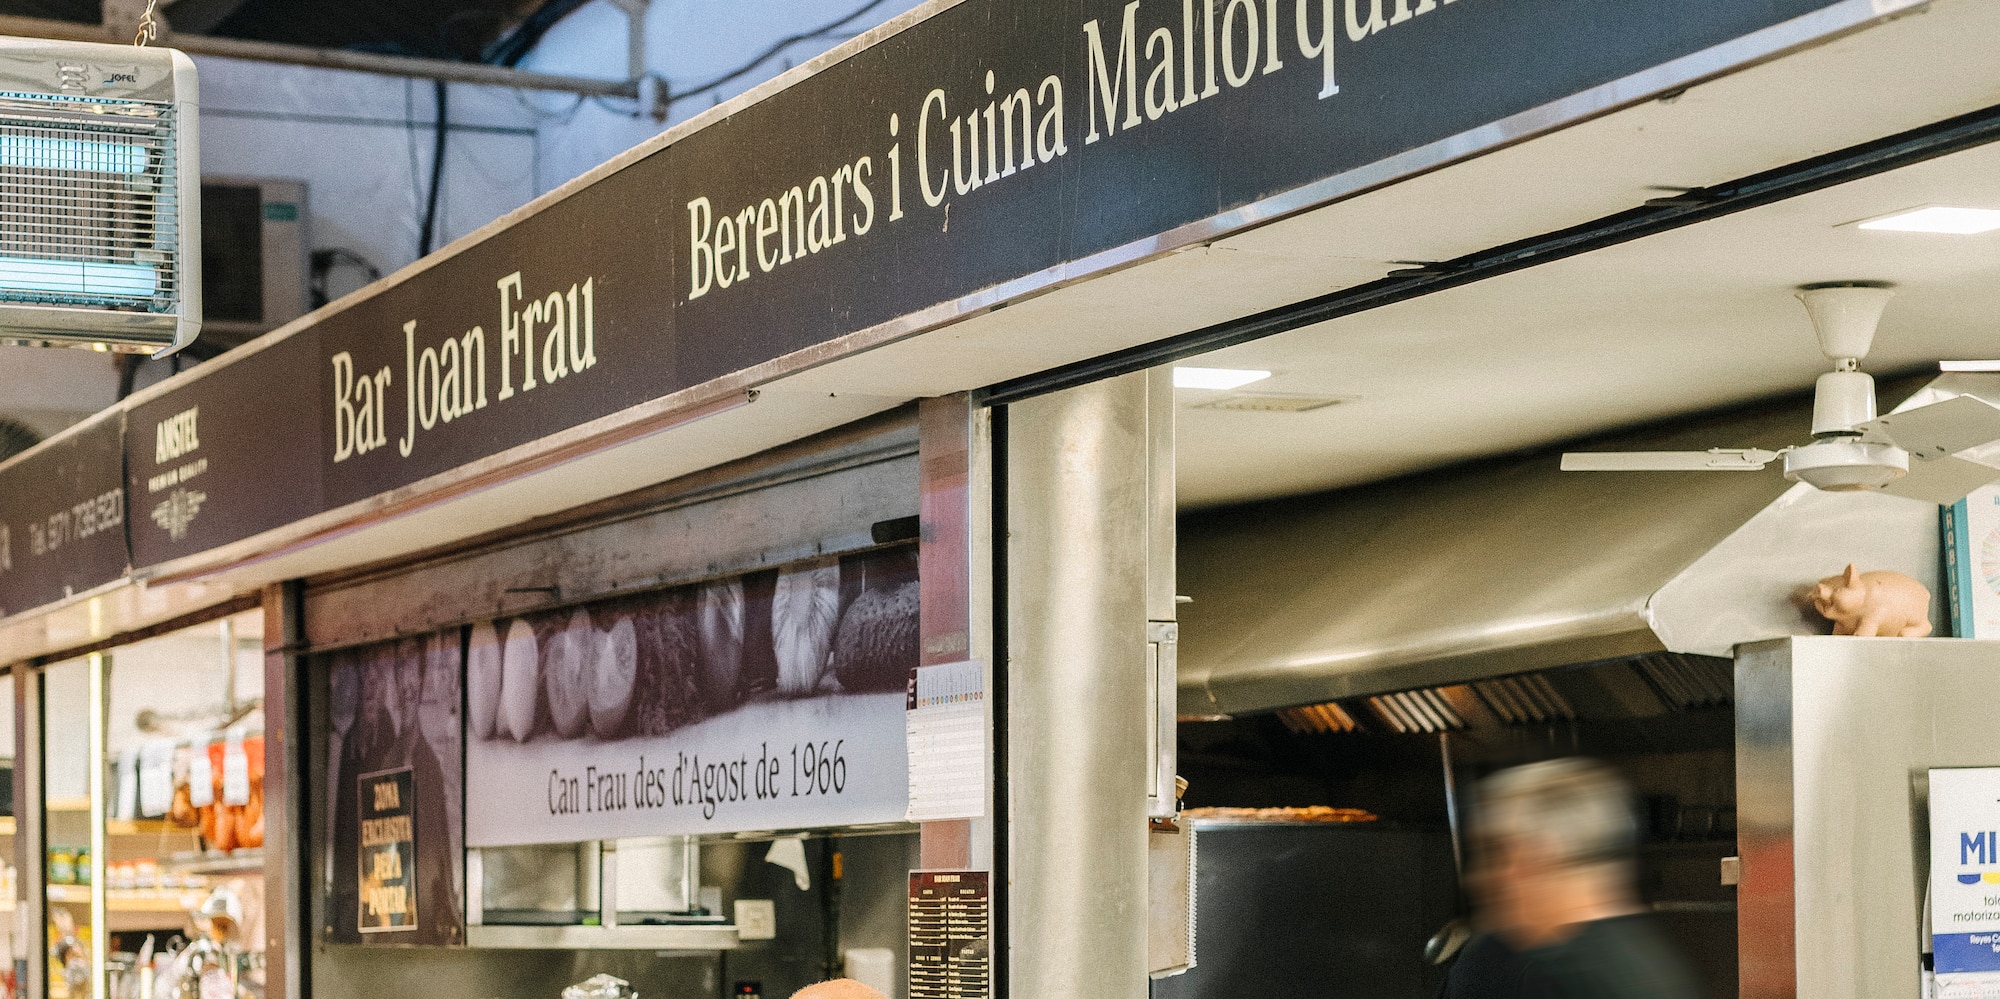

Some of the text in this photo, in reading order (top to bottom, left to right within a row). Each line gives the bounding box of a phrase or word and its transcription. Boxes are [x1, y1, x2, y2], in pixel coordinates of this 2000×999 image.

[103, 73, 136, 83] JOFEL
[687, 156, 875, 300] Berenars
[888, 112, 904, 222] i
[918, 69, 1067, 207] Cuina
[332, 270, 597, 463] Bar Joan Frau
[155, 405, 200, 464] AMSTEL
[549, 739, 846, 820] Can Frau des d'Agost de 1966
